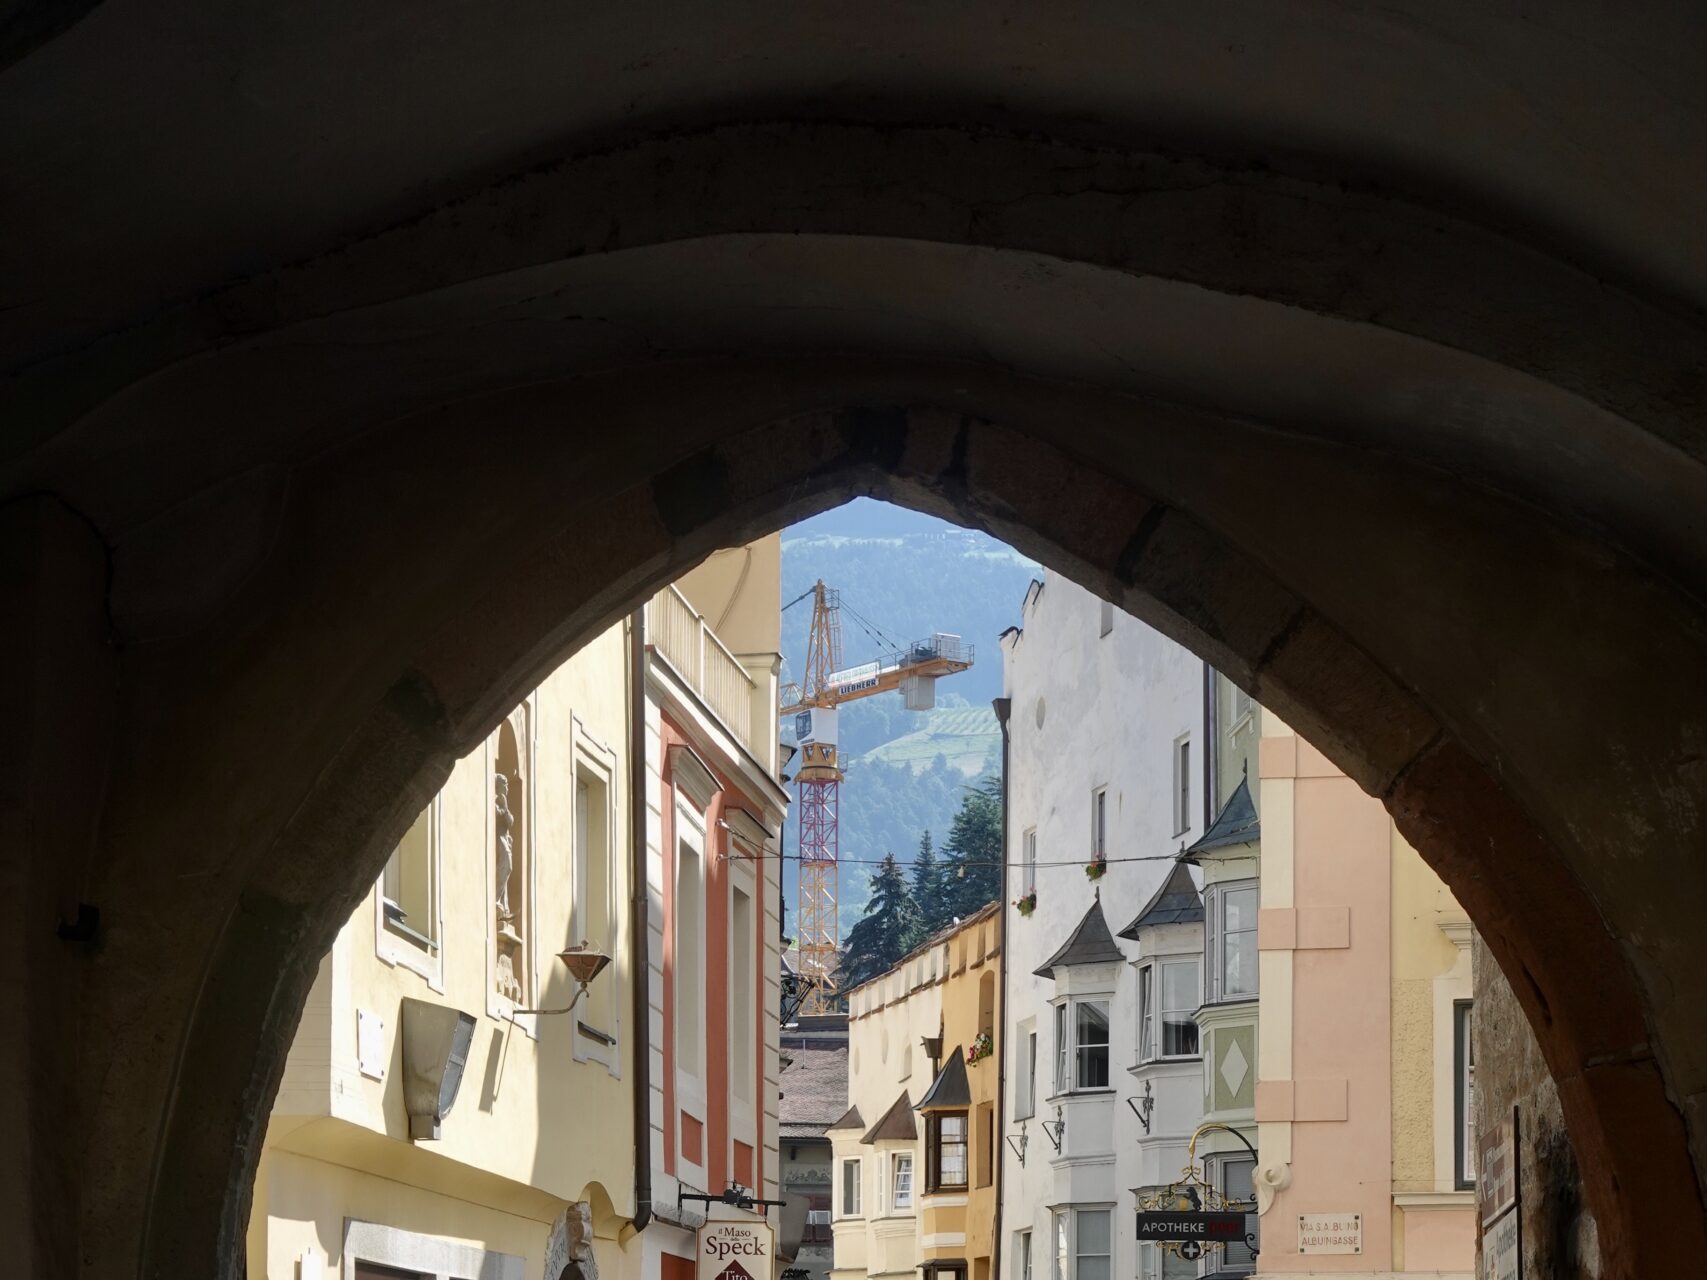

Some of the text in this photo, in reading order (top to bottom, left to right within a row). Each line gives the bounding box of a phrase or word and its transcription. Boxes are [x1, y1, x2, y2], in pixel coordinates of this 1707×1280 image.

[841, 679, 876, 694] LIEBHERR
[724, 1227, 751, 1238] Maso
[1142, 1222, 1205, 1233] APOTHEKE
[705, 1236, 766, 1260] Speck
